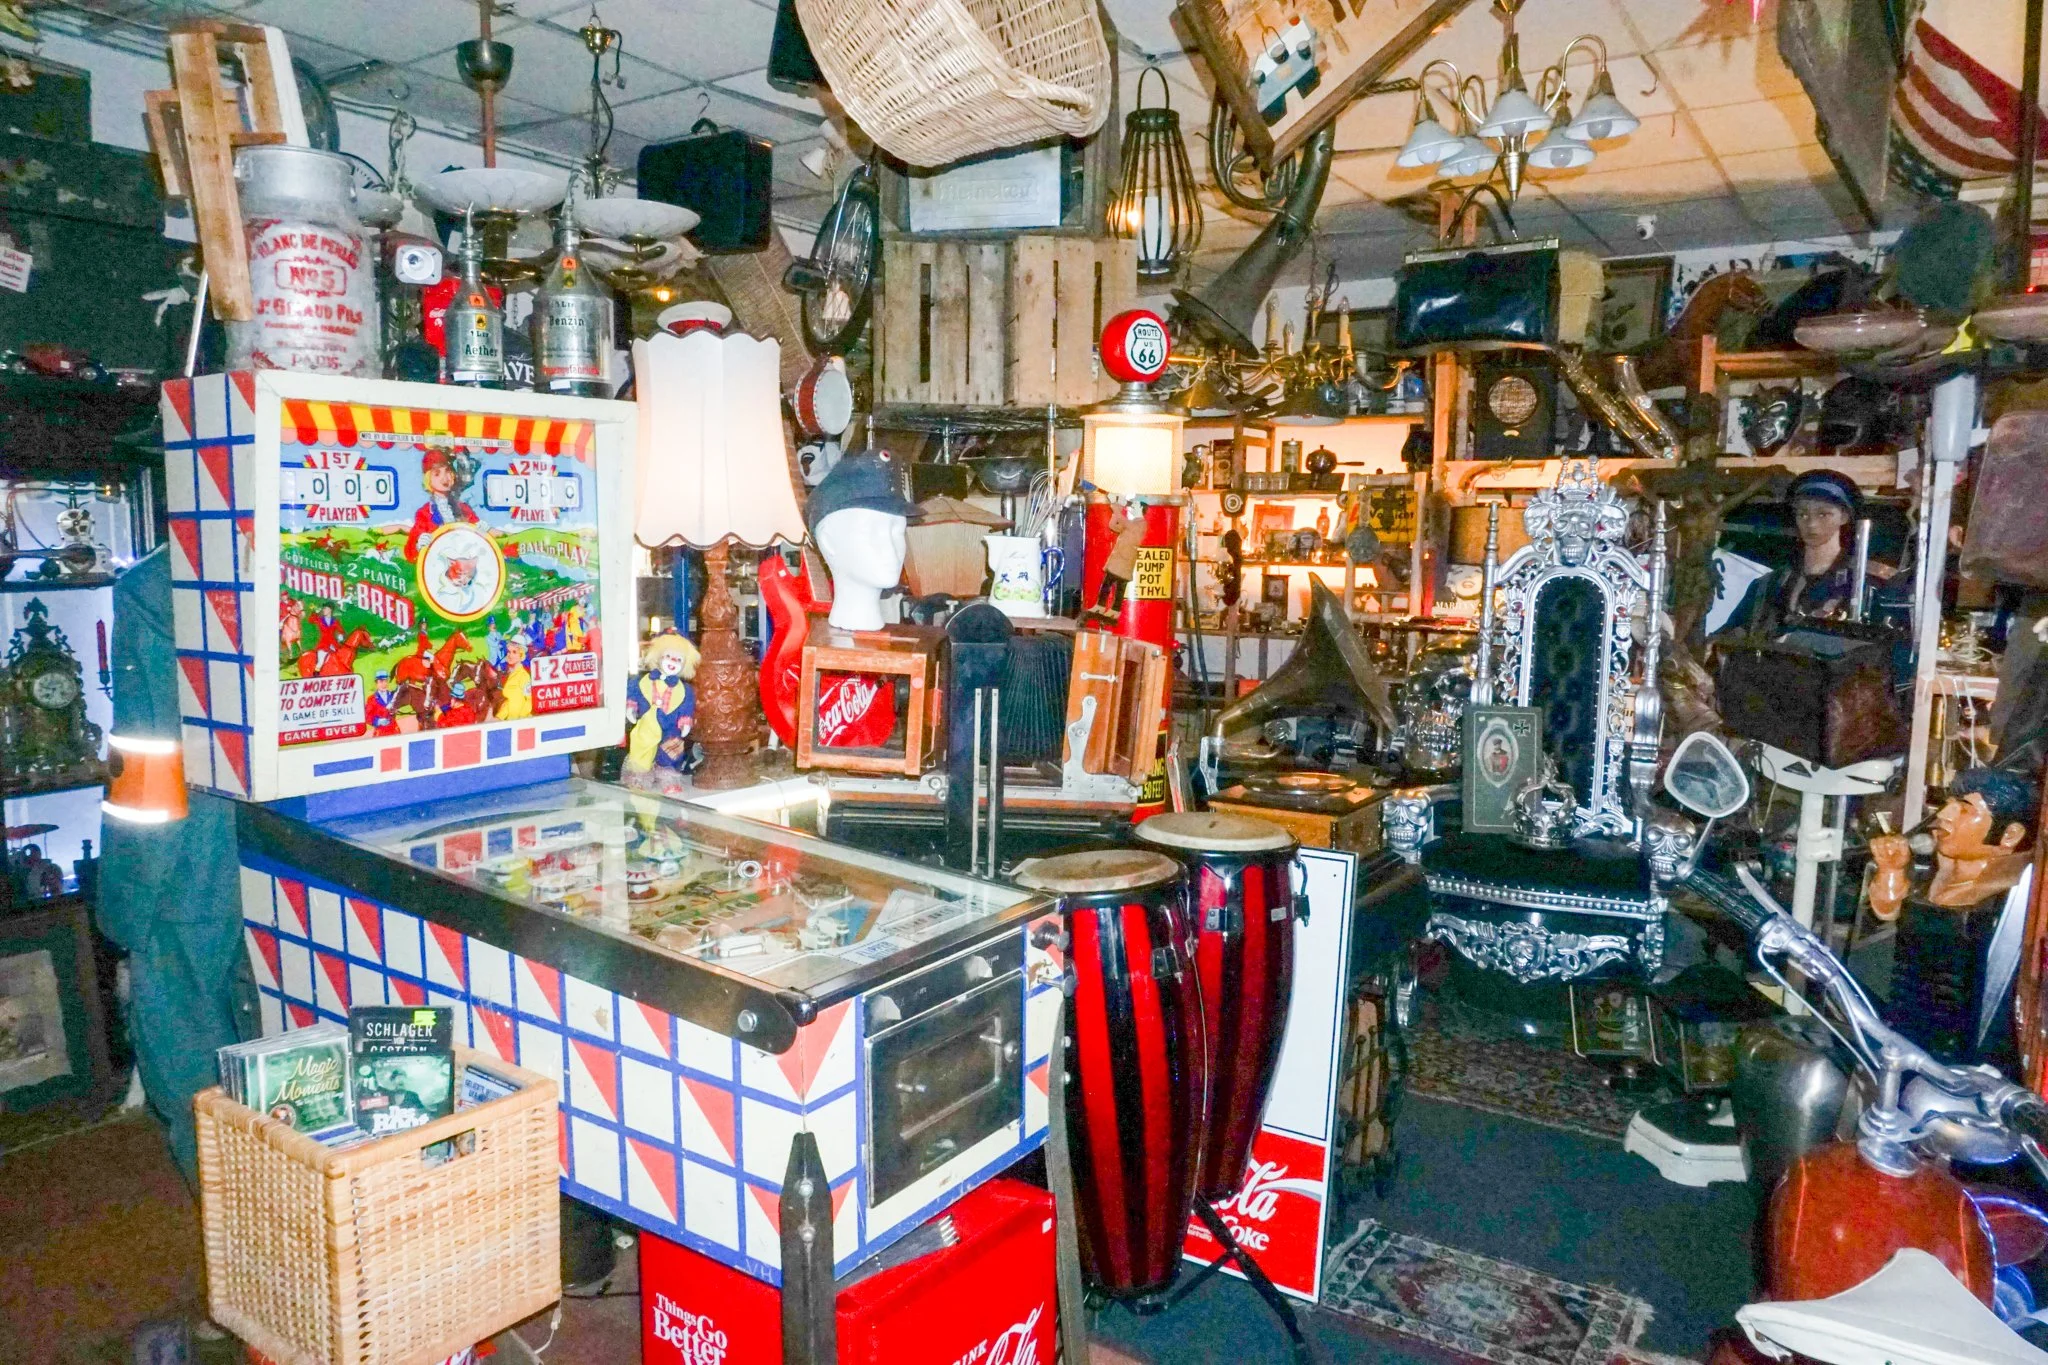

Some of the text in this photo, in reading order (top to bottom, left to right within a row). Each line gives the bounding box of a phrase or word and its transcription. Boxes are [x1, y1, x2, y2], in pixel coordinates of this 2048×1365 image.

[549, 313, 585, 328] Benzin
[1137, 328, 1158, 337] ROUTE
[465, 344, 498, 357] Aether
[1139, 348, 1156, 364] 66
[320, 452, 351, 469] 1ST
[519, 460, 548, 475] 2ND
[320, 508, 358, 521] PLAYER
[518, 542, 546, 556] BALL
[557, 541, 591, 567] PLAY
[1136, 550, 1171, 561] EALED
[285, 552, 407, 593] GOTTLIEB'S 2 PLAYER
[1136, 562, 1165, 572] PUMP
[1139, 574, 1162, 584] POT
[357, 581, 413, 630] BRED
[549, 658, 559, 679] 2
[564, 659, 596, 673] PLAYERS
[280, 677, 357, 696] IT'S MORE FUN
[537, 683, 594, 700] CAN PLAY
[280, 698, 294, 711] TO
[548, 699, 559, 707] THE
[561, 698, 578, 706] SAME
[580, 695, 594, 703] TIME
[282, 706, 356, 722] A GAME OF SKILL
[284, 725, 357, 742] GAME OVER
[366, 1022, 433, 1037] SCHLAGER
[288, 1055, 338, 1083] Magic
[270, 1076, 342, 1105] Moments
[1220, 1215, 1271, 1251] Coke
[655, 1292, 728, 1349] Things Go
[652, 1306, 727, 1364] Better
